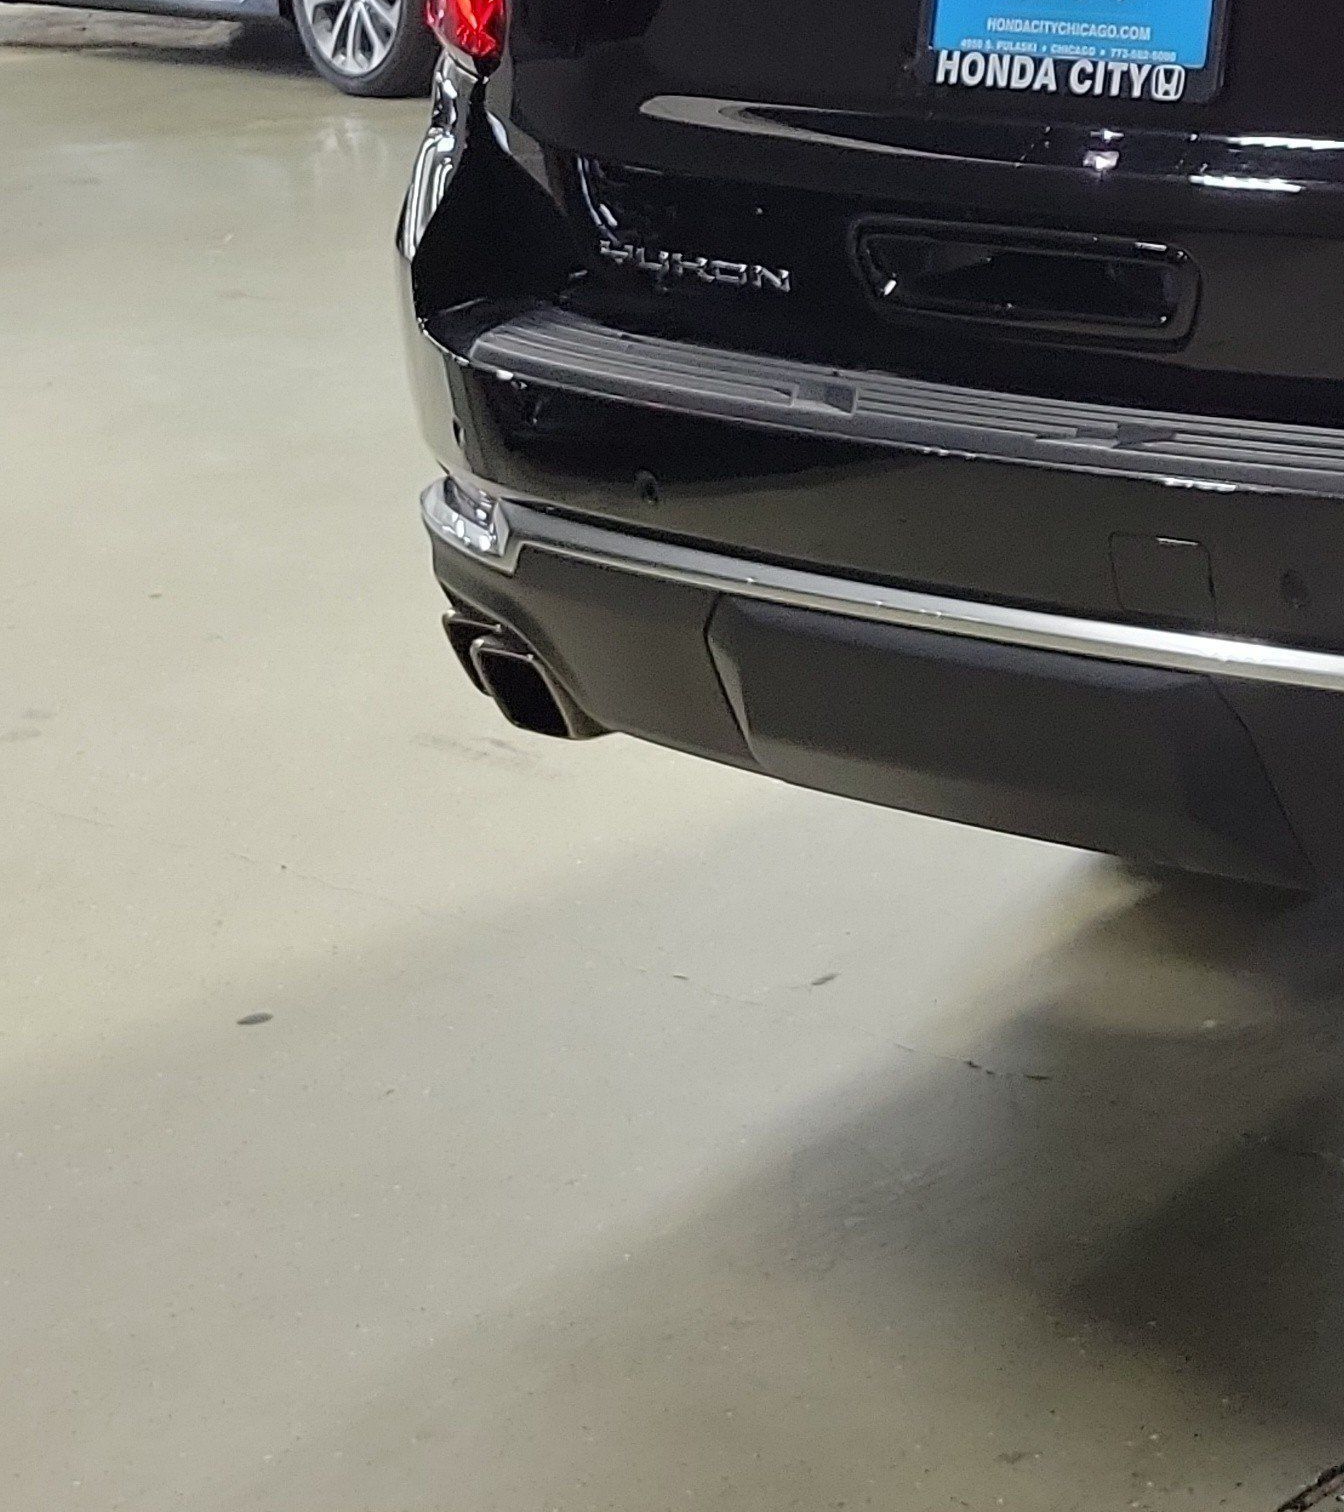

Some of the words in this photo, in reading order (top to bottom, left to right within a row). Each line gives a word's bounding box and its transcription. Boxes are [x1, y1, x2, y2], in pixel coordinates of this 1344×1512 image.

[987, 17, 1151, 40] HONDACITYCHICAGO.COM
[1050, 44, 1096, 56] CHICAGO
[935, 49, 1057, 92] HONDA
[1068, 58, 1152, 98] CITY
[600, 239, 791, 292] YUKON
